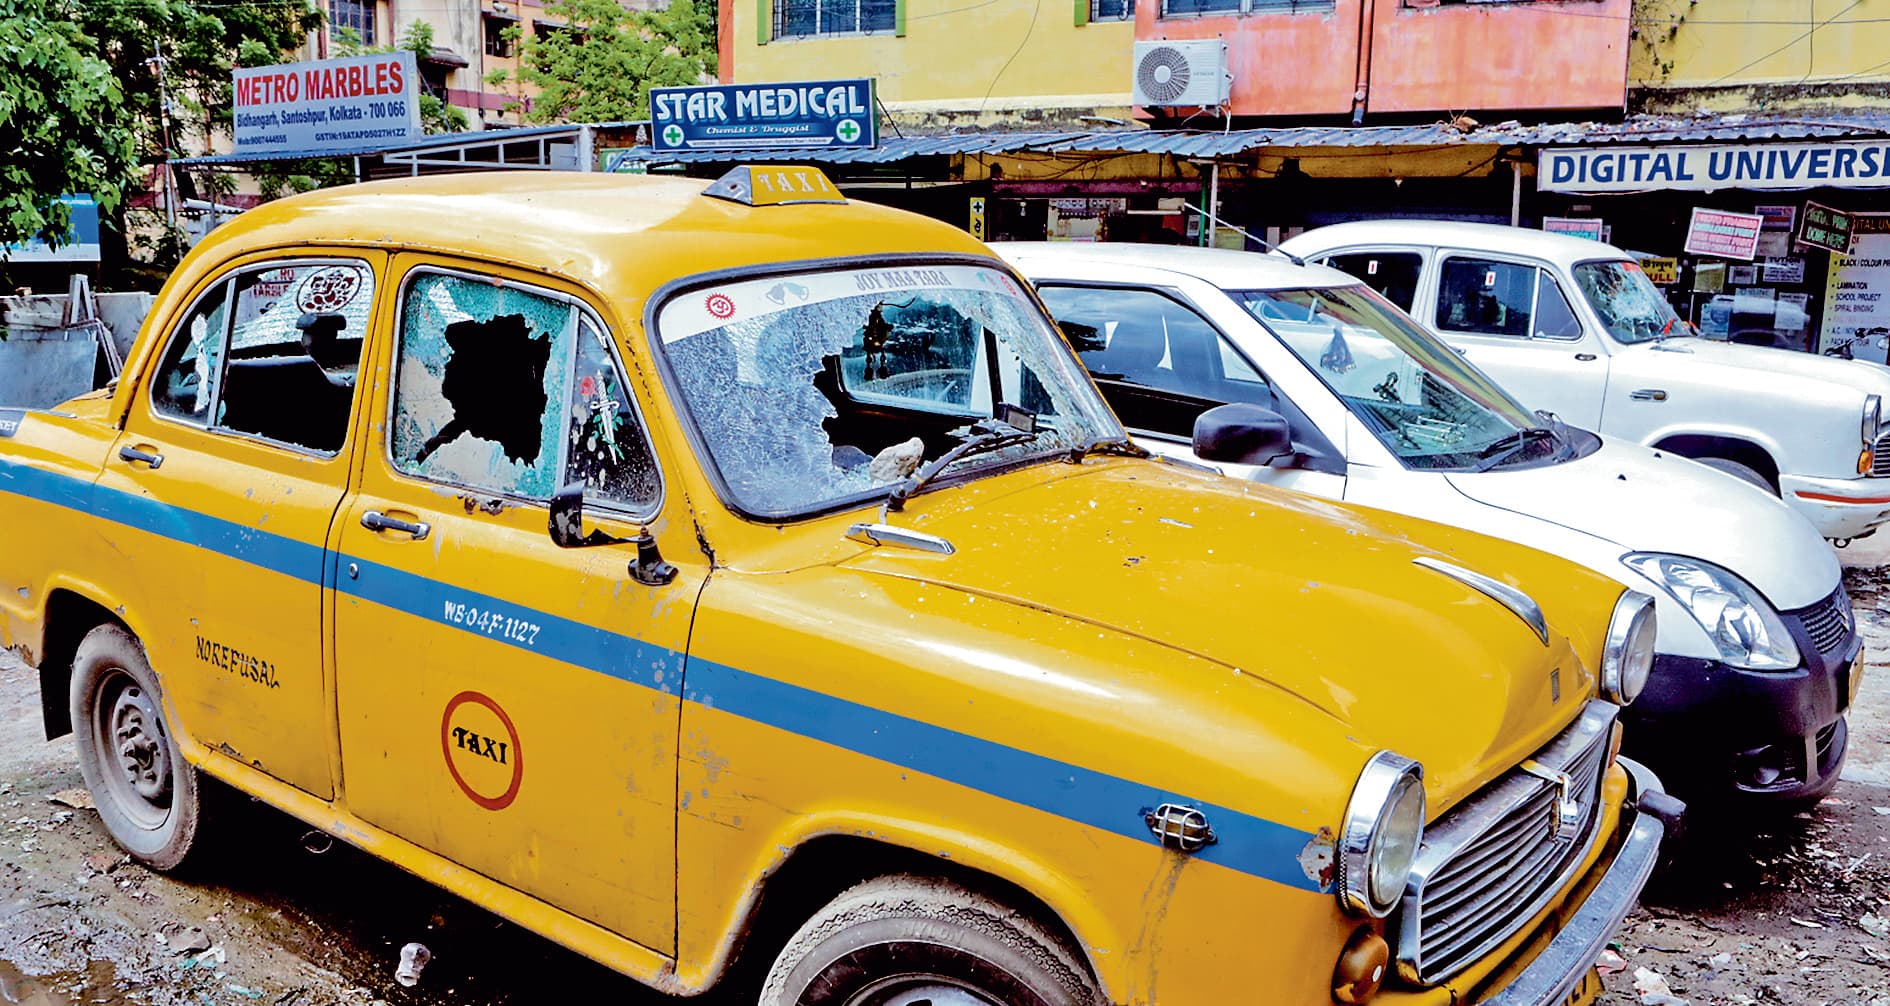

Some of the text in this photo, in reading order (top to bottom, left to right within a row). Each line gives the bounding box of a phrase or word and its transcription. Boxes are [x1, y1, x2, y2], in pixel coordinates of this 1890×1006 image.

[237, 61, 403, 107] METRO MARBLES
[281, 107, 328, 126] Santoshpur,
[329, 105, 362, 122] Kolkata
[369, 103, 385, 118] 700
[387, 101, 405, 117] 066
[655, 86, 866, 122] STAR MEDICAL
[706, 124, 810, 135] Chemist & Druggist
[1552, 152, 1694, 183] DIGITAL
[757, 172, 829, 193] TAXI
[853, 269, 953, 291] JOY MAA TARA
[1647, 273, 1673, 282] ULL
[1836, 293, 1881, 301] SCHOOL PROJECT
[452, 726, 508, 765] TAXI
